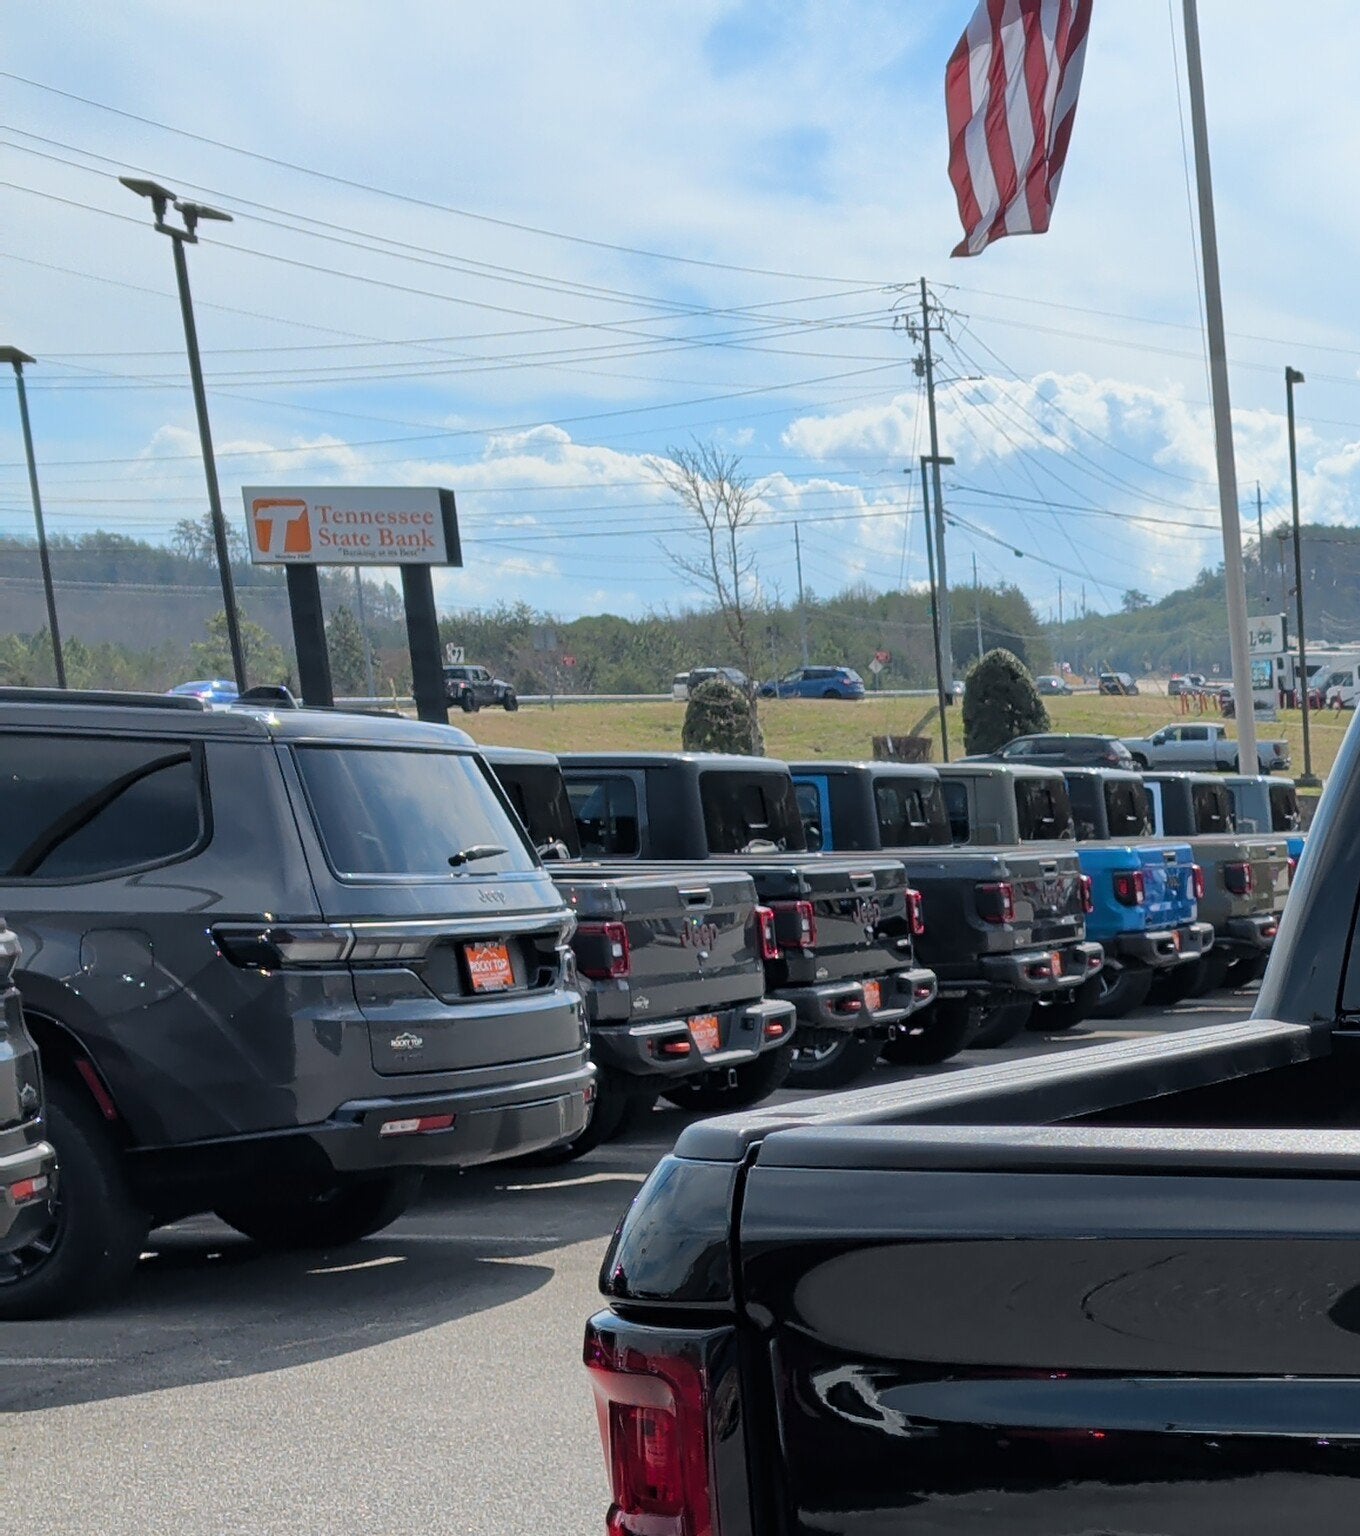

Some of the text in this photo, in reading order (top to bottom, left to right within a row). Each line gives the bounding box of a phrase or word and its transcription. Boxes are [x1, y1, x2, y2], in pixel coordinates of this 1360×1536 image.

[314, 506, 435, 525] Tennessee
[318, 527, 436, 547] State Bank
[681, 917, 719, 951] Jeep
